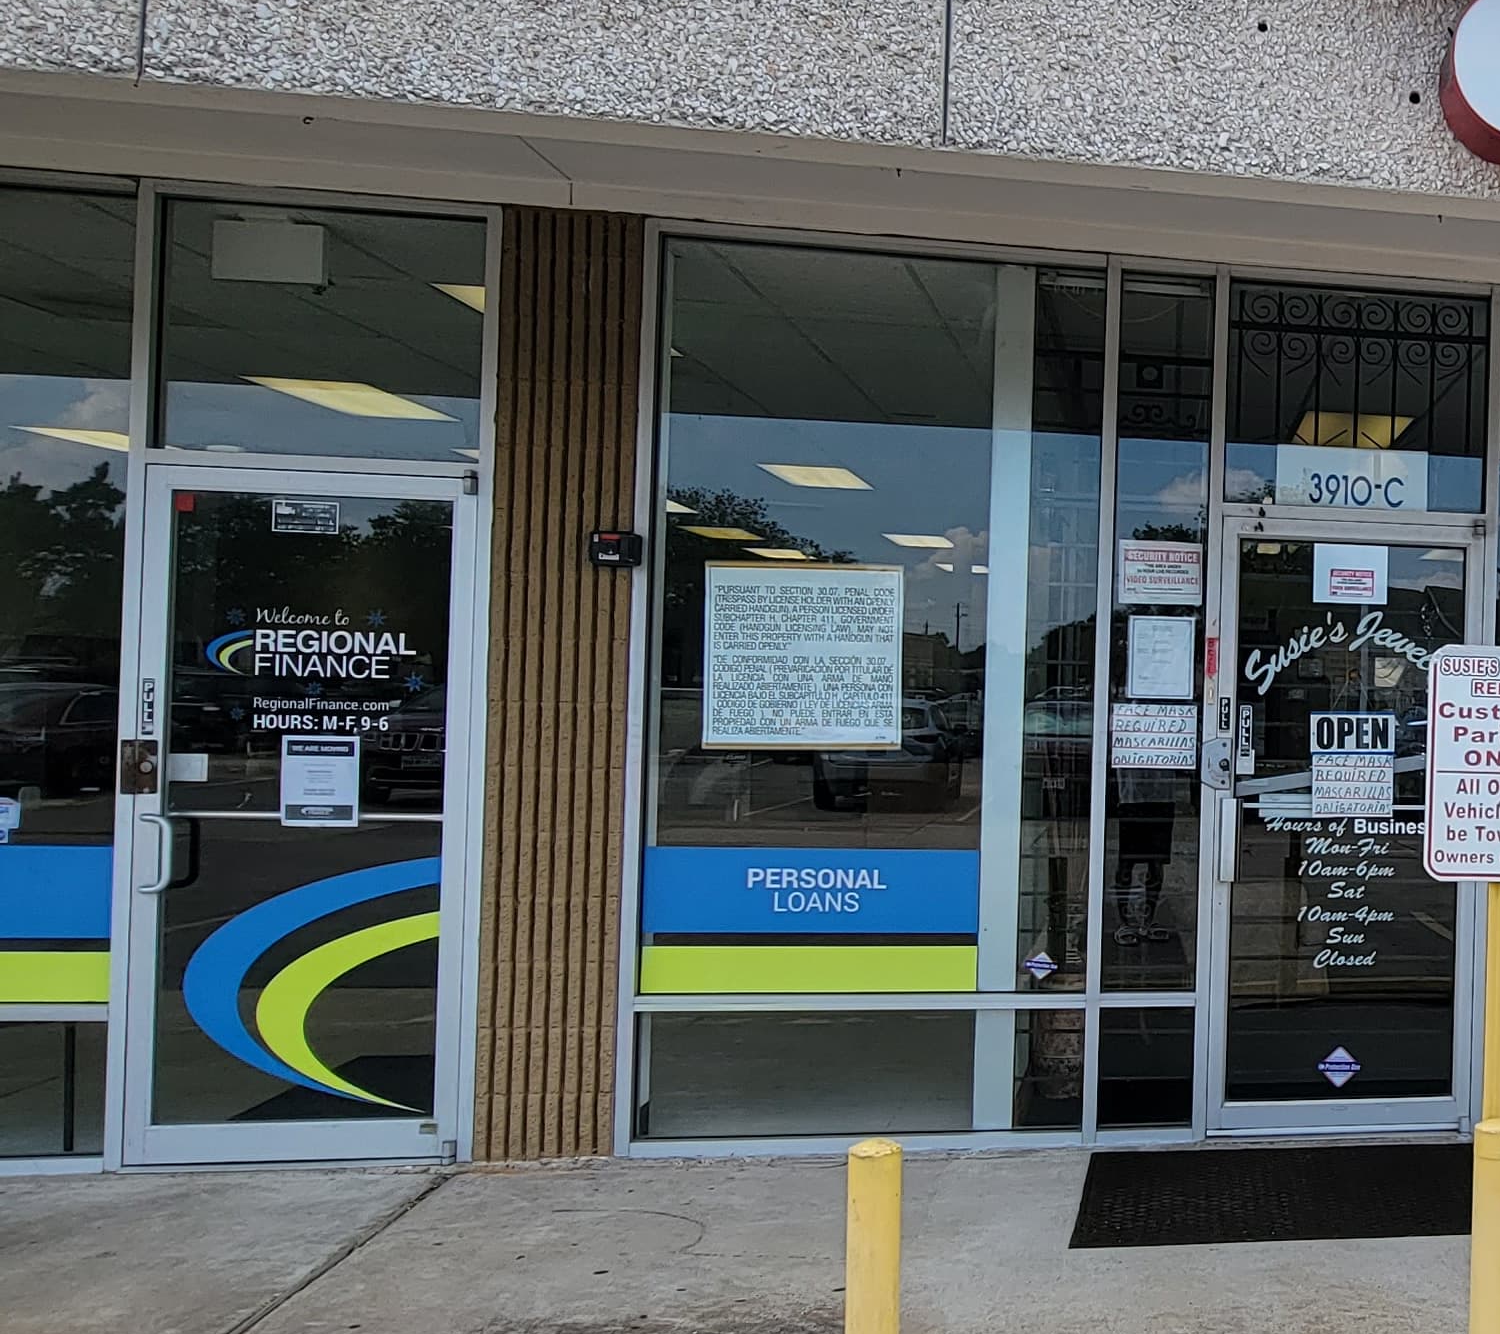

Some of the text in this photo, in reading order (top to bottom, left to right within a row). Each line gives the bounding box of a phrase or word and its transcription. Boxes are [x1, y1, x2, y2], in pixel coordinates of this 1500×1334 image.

[1308, 473, 1405, 508] 3910-C
[1127, 550, 1198, 563] SECURITY NOTICE
[1127, 575, 1198, 586] VIDEO SURVEILLANCE
[764, 586, 776, 595] TO
[780, 586, 813, 595] SECTION
[845, 587, 869, 596] PENAL
[874, 588, 895, 597] CODE
[757, 595, 768, 604] BY
[769, 595, 800, 604] LICENSE
[801, 596, 832, 605] HOLDER
[833, 596, 853, 605] WITH
[854, 597, 865, 605] AN
[866, 597, 895, 606] OPENLY
[256, 606, 350, 626] Welcome to
[714, 604, 748, 612] CARRIED
[791, 605, 798, 613] A
[799, 605, 830, 614] PERSON
[831, 606, 867, 614] LICENSED
[868, 606, 895, 615] UNDER
[714, 613, 766, 622] SUBCHAPTER
[781, 614, 817, 623] CHAPTER
[841, 615, 894, 624] GOVERNMENT
[714, 622, 736, 631] CODE
[740, 623, 781, 633] (HANDGUN
[785, 624, 826, 633] LICENSING
[857, 625, 875, 634] MAY
[878, 626, 894, 634] NOT
[255, 629, 416, 656] REGIONAL
[714, 632, 894, 643] ENTER THIS PROPERTY WITH A HANDGUN THAT
[714, 641, 721, 650] IS
[723, 641, 756, 650] CARRIED
[732, 655, 788, 664] CONFORMIDAD
[793, 656, 809, 664] CON
[1245, 611, 1349, 695] Susie's
[254, 653, 390, 679] FINANCE
[1442, 657, 1498, 676] SUSIE'S
[713, 673, 893, 683] LA LICENCIA CON UNA ARMA DE MANO
[143, 682, 154, 722] PULL
[253, 697, 390, 712] RegionalFinance.com
[1116, 705, 1195, 716] FACE MASK
[713, 708, 893, 718] DE FUEGO NO PUEDE ENTRAR EN ESTA
[1221, 698, 1230, 729] PULL
[253, 714, 319, 730] HOURS:
[361, 717, 389, 731] 9-6
[1241, 710, 1250, 746] PULL
[1316, 717, 1389, 750] OPEN
[1317, 755, 1392, 767] FACE MASK
[1456, 779, 1480, 795] All
[1264, 816, 1323, 832] Hours
[1328, 817, 1348, 836] of
[1447, 825, 1467, 841] be
[1305, 837, 1390, 857] Mon-Fri
[1434, 849, 1494, 864] Owners
[1297, 860, 1396, 879] 10am-6pm
[747, 868, 888, 889] PERSONAL
[1327, 882, 1365, 899] Sat
[773, 891, 860, 913] LOANS
[1296, 905, 1394, 924] 10am-4pm
[1326, 927, 1365, 944] Sun
[1313, 949, 1377, 968] Closed
